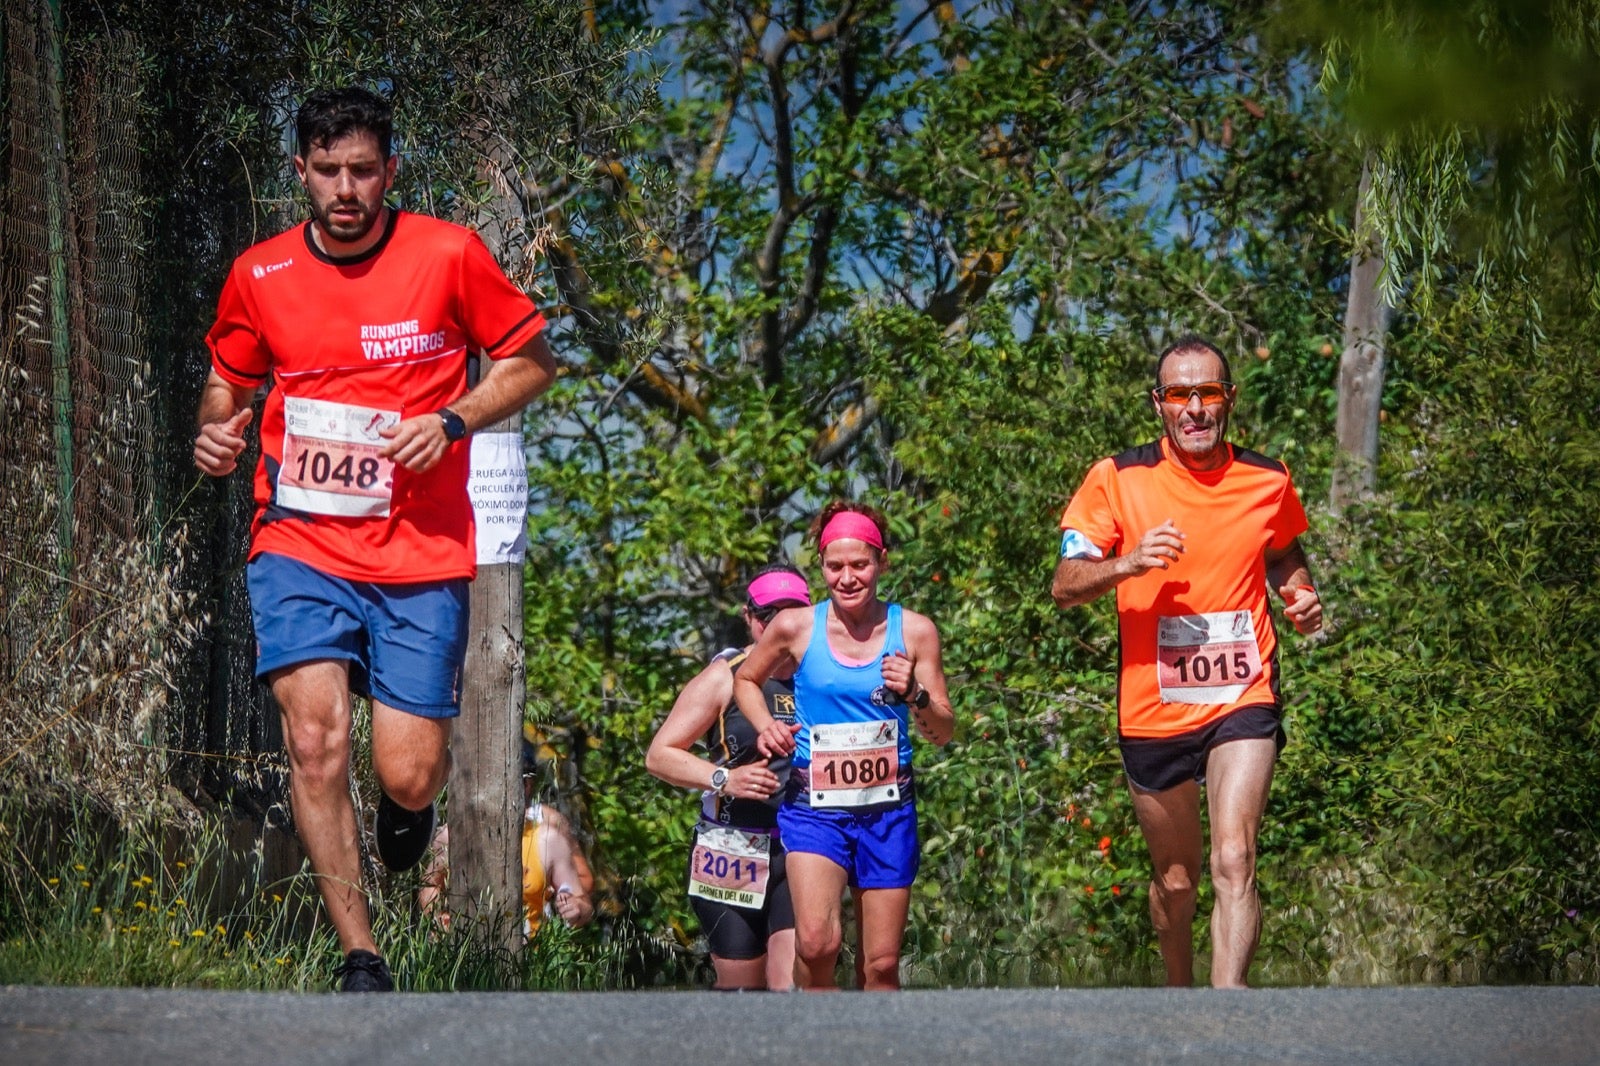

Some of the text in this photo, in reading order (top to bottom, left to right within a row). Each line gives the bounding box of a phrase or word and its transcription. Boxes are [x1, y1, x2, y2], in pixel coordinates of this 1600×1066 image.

[361, 320, 419, 339] RUNNING
[361, 331, 446, 361] VAMPIROS
[296, 449, 380, 490] 1048
[476, 469, 507, 479] RUEGA
[509, 469, 515, 478] A
[473, 484, 515, 494] CIRCULEN
[473, 499, 509, 510] RÓXIMO
[486, 515, 505, 525] POR
[1173, 652, 1251, 683] 1015
[824, 757, 890, 785] 1080
[703, 851, 757, 883] 2011
[698, 885, 754, 904] CARMEN DEL MAR
